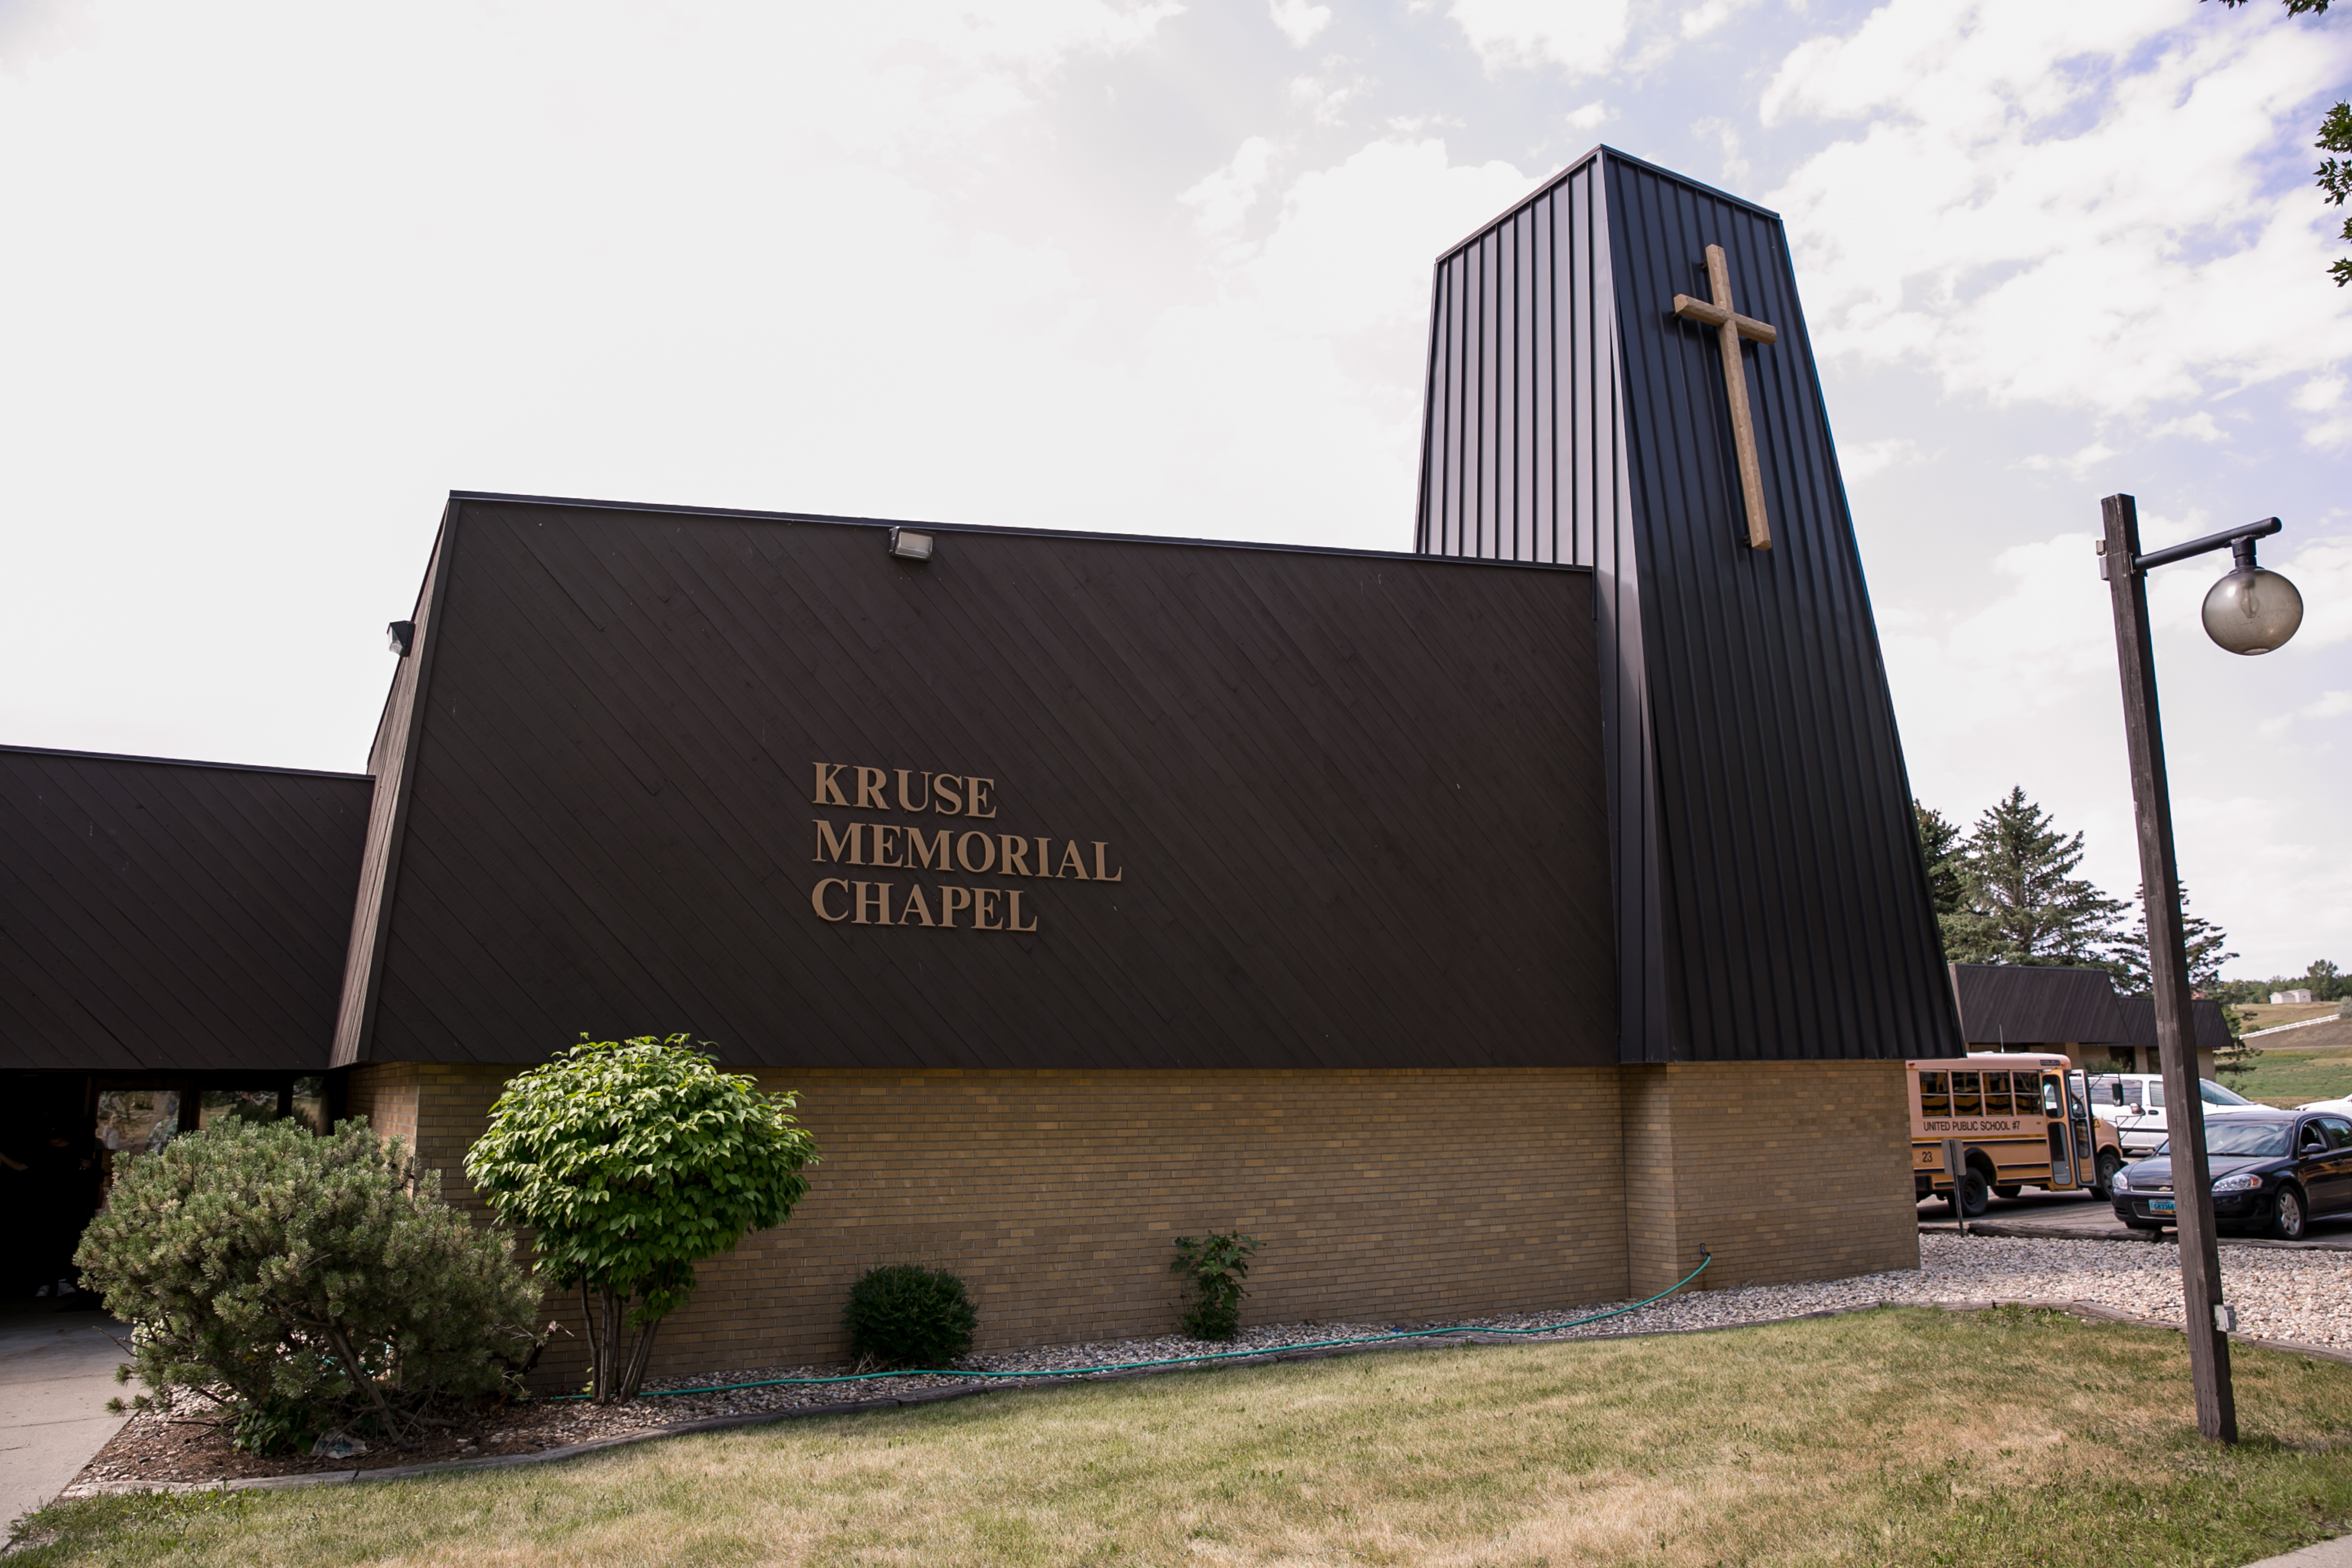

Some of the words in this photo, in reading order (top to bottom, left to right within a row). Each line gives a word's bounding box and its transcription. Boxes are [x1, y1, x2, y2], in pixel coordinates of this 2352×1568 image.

[812, 762, 997, 818] KRUSE
[812, 819, 1122, 881] MEMORIAL
[811, 878, 1038, 931] CHAPEL
[1923, 1121, 1950, 1131] UNITED
[1953, 1121, 1978, 1131] PUBLIC
[1980, 1121, 2010, 1131] SCHOOL
[2012, 1121, 2020, 1130] #7
[1922, 1152, 1933, 1163] 23
